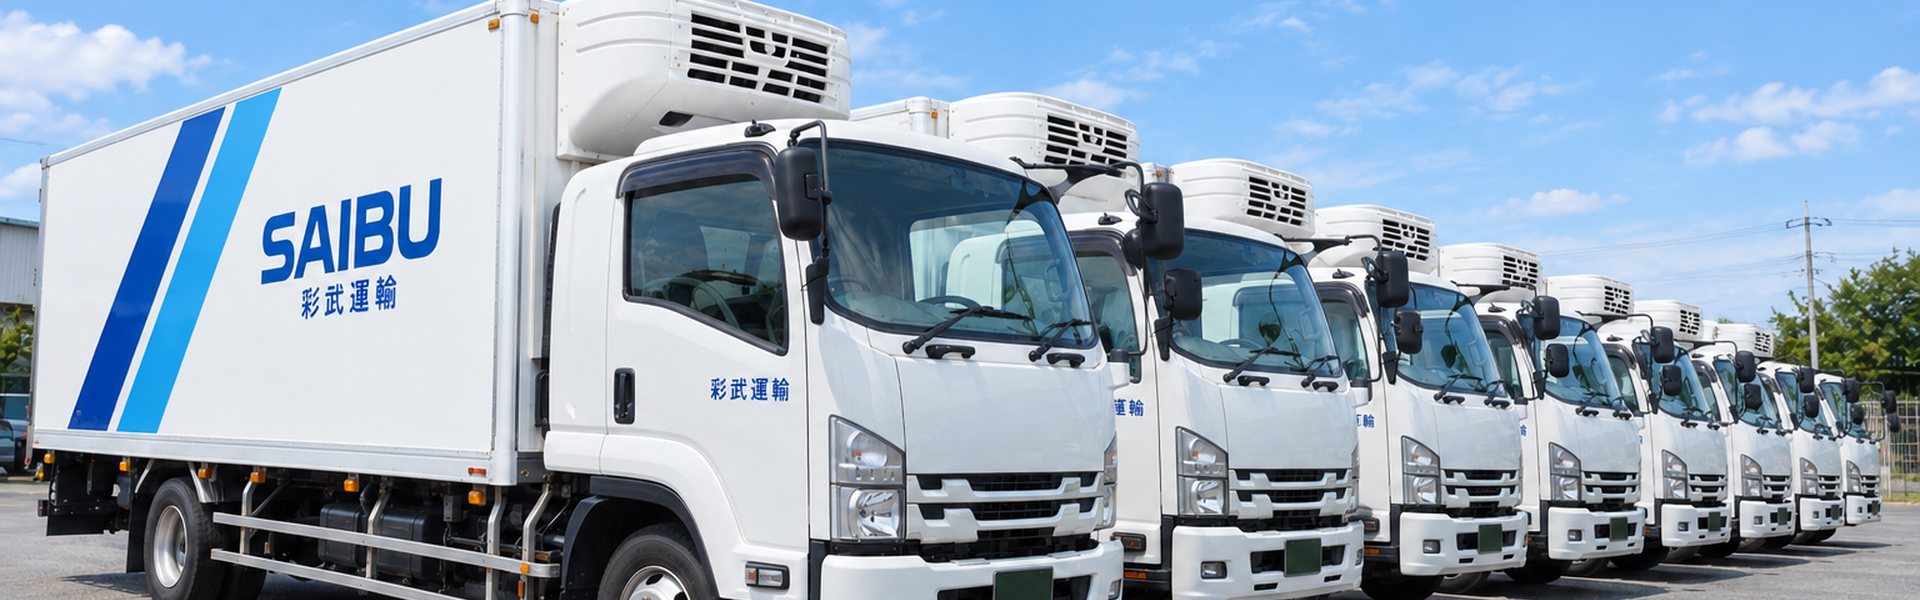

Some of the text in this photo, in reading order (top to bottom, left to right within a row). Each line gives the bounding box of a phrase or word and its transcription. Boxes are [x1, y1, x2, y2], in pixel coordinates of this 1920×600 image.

[261, 177, 442, 284] SAIBU
[301, 274, 397, 320] 彩武運輸
[710, 377, 790, 402] 彩武運輸
